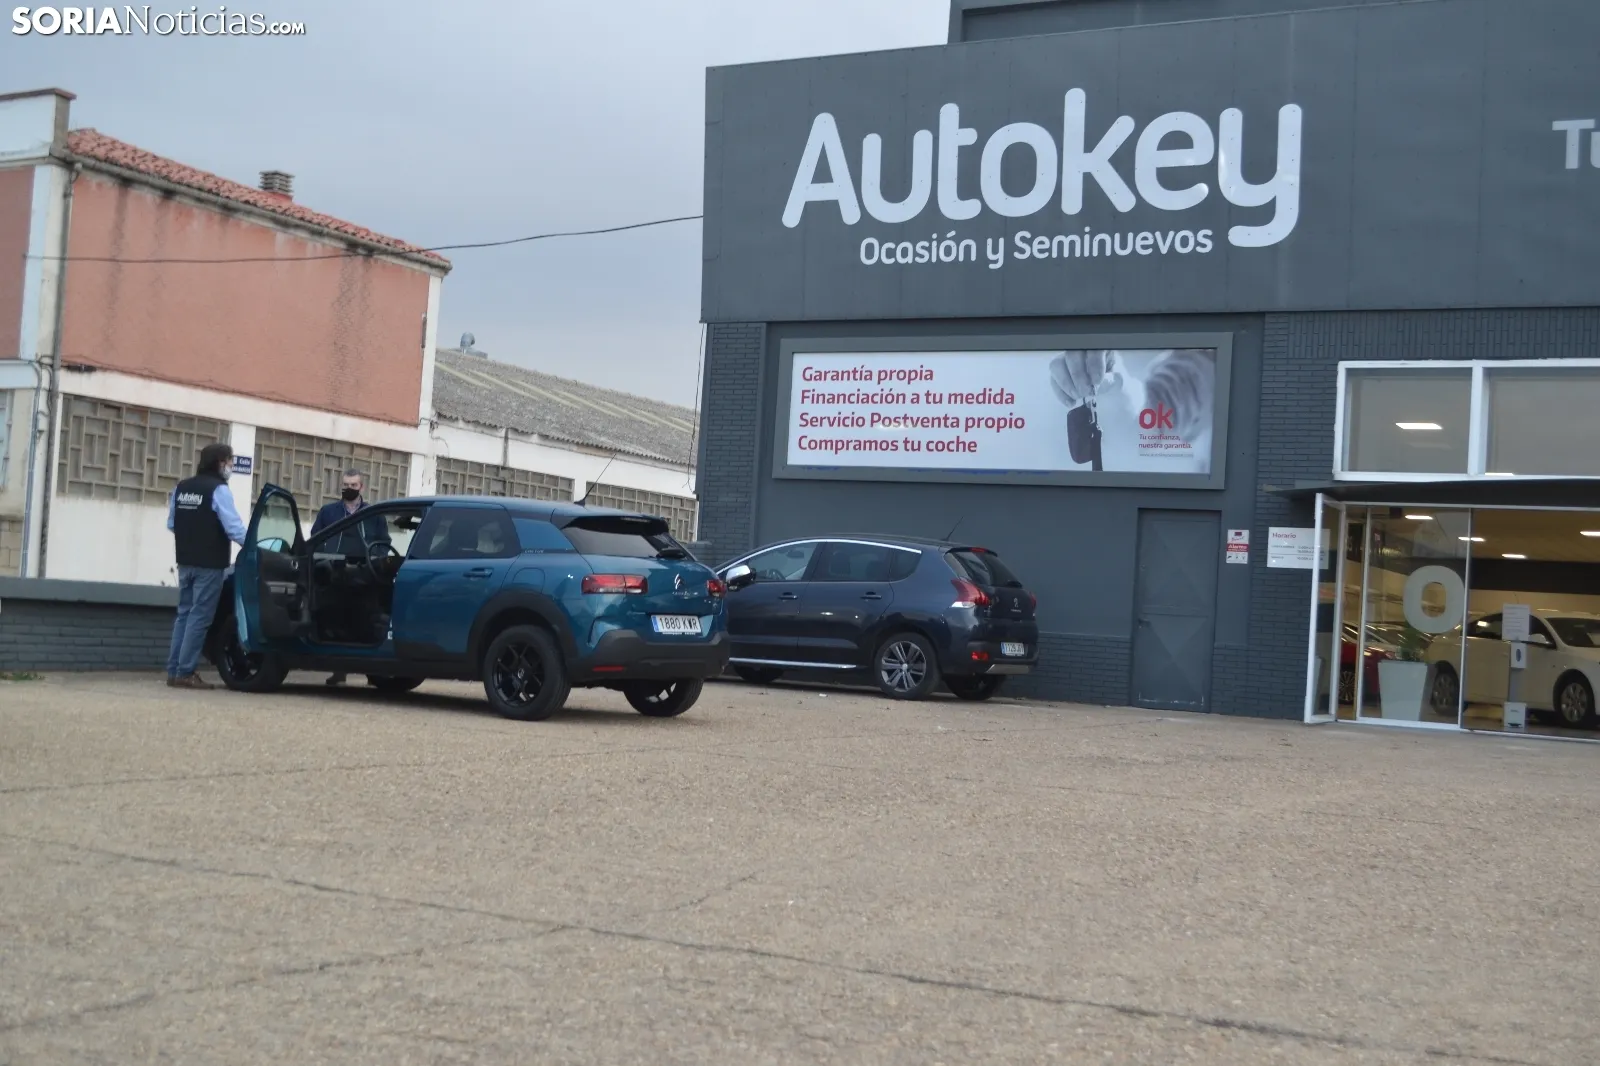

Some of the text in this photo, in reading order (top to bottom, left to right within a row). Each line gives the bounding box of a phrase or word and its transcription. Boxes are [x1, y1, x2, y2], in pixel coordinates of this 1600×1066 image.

[782, 88, 1303, 248] Autokey
[859, 226, 1213, 270] Ocasión y Seminuevos
[801, 365, 934, 385] Garantía propia
[800, 388, 1015, 405] Financiación a tu medida
[799, 411, 1026, 433] Servicio Postventa propio
[1138, 402, 1173, 430] ok
[798, 435, 978, 455] Compramos tu coche
[659, 617, 681, 630] 1880
